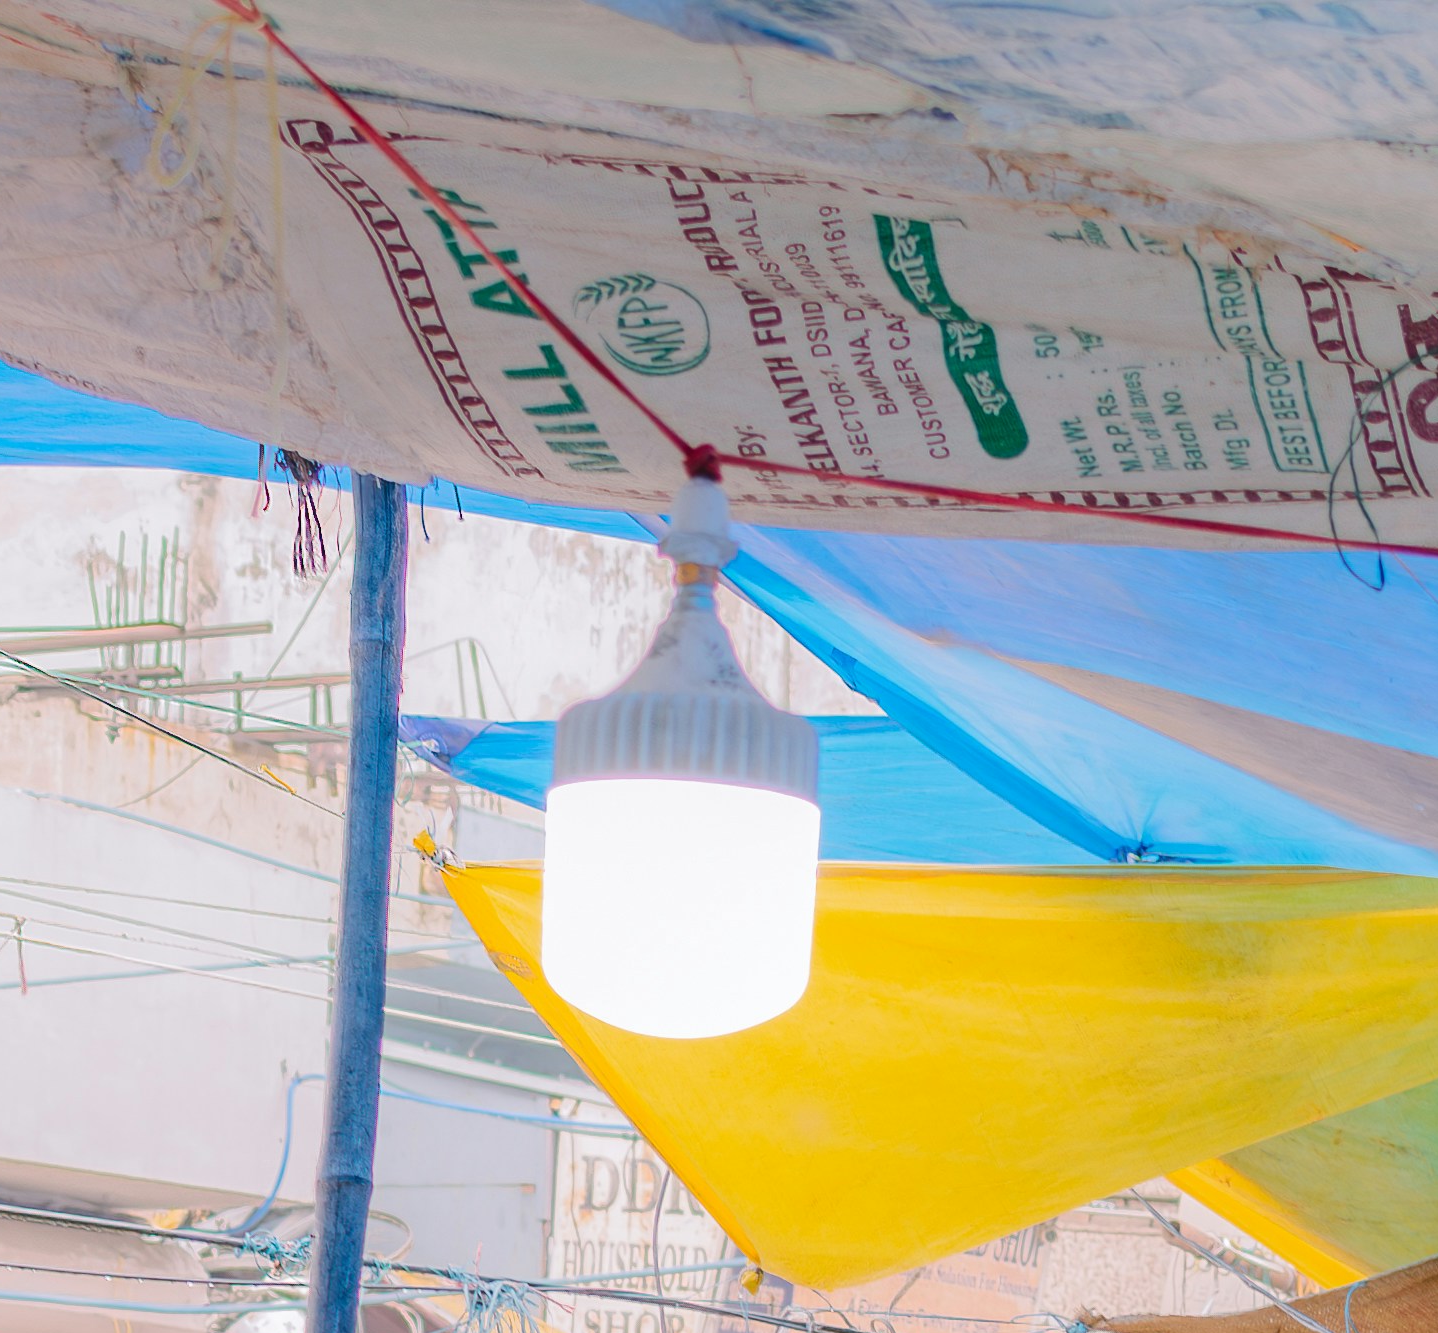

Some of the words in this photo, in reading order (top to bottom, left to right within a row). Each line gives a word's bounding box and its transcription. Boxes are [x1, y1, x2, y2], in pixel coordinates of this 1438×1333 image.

[1211, 267, 1244, 319] FROM
[848, 325, 899, 416] BAWANA,
[1264, 356, 1304, 424] BEFOR
[502, 344, 630, 474] MILL
[893, 356, 950, 460] CUSTOMER
[1073, 448, 1102, 478] Net
[1175, 424, 1208, 474] Batch
[1224, 436, 1252, 472] Mfg
[1283, 428, 1314, 468] BEST
[563, 1239, 708, 1292] HOUSEHOLD
